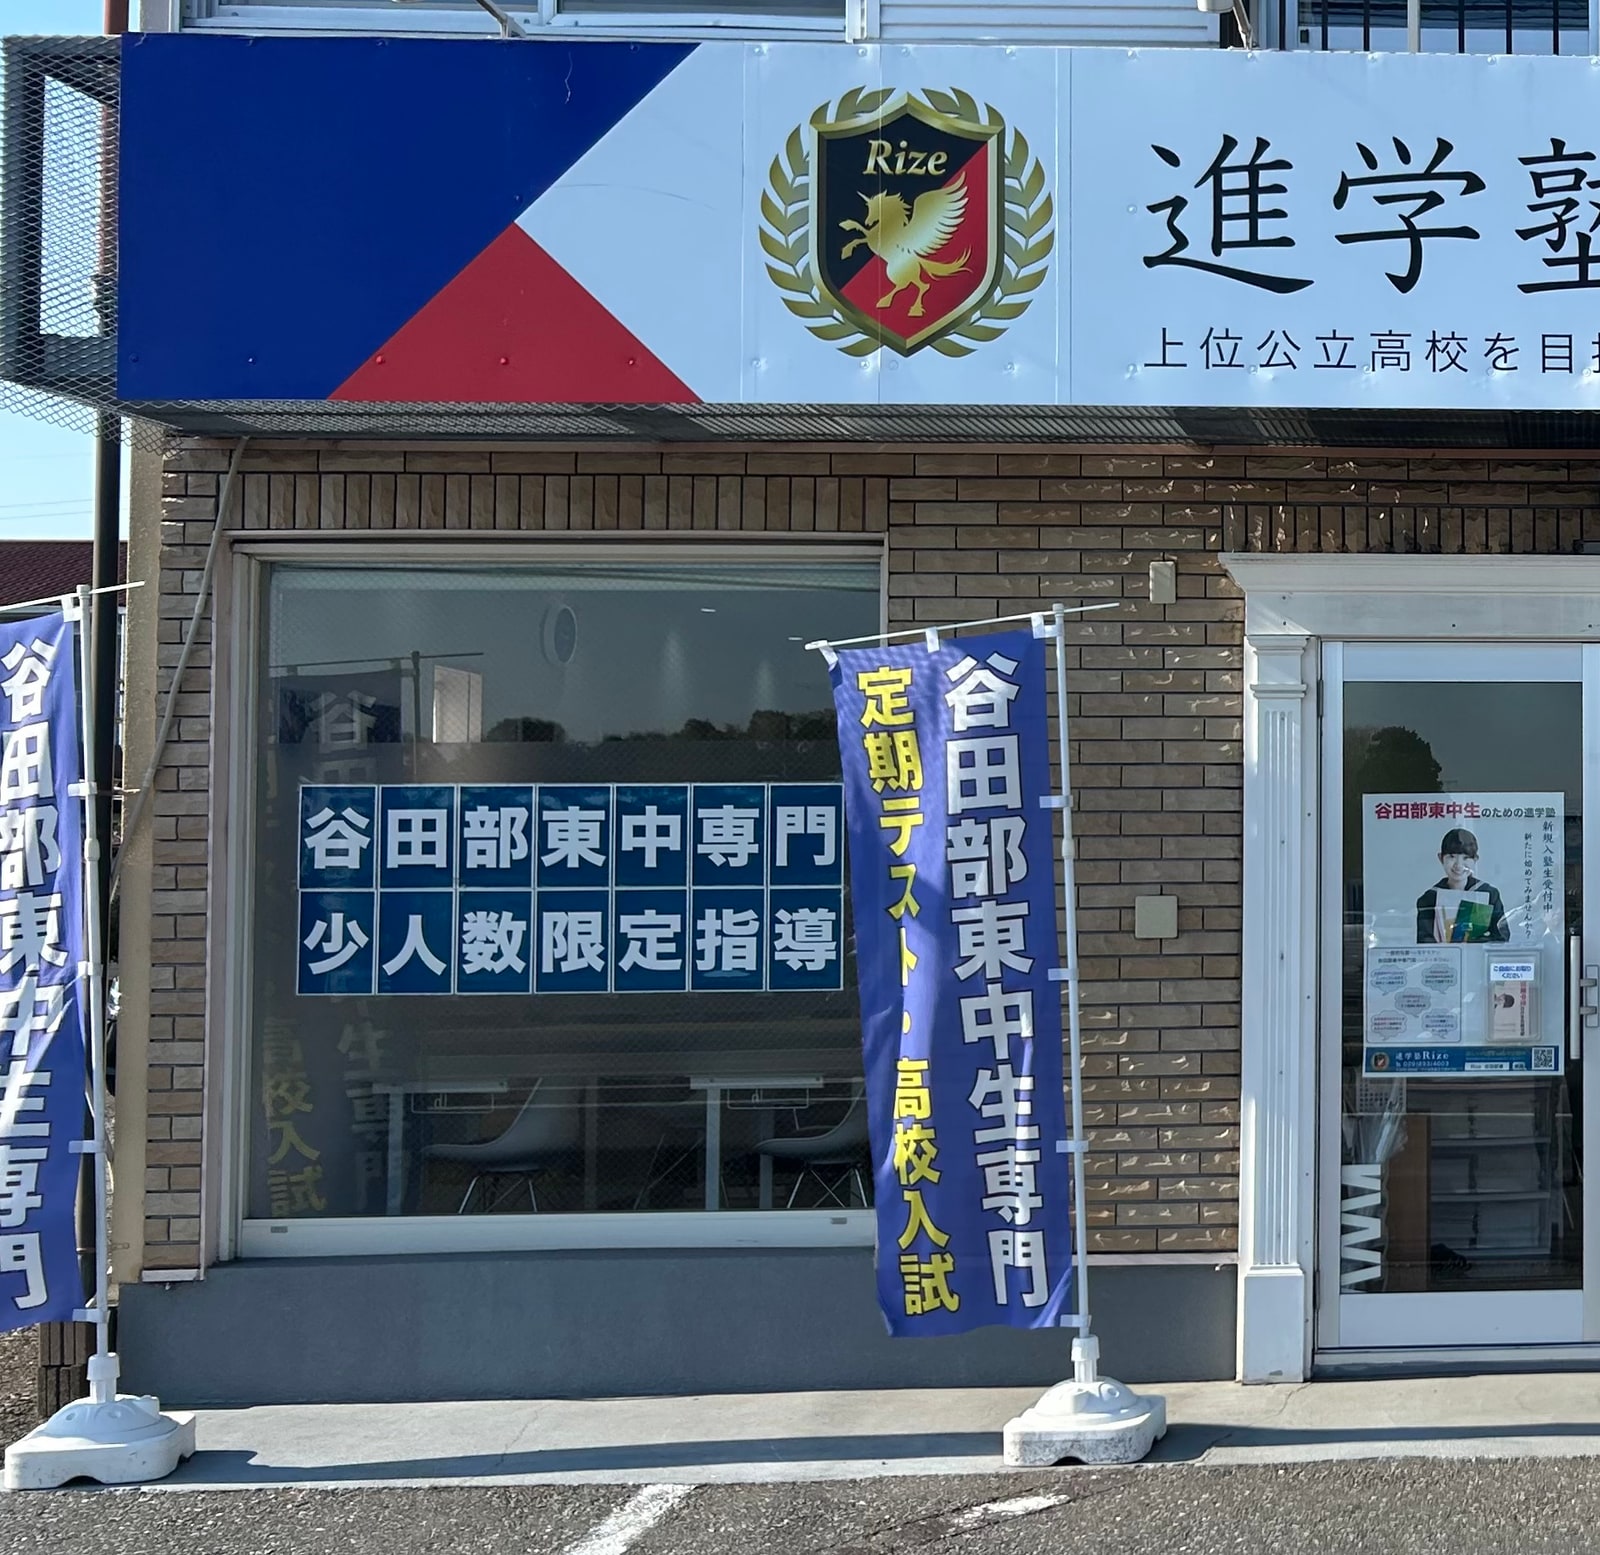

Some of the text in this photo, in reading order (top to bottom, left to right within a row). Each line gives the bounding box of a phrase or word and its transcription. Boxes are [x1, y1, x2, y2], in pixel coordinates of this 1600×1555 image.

[862, 138, 948, 178] Rize
[304, 805, 837, 871] 谷田部東中専門
[304, 907, 837, 977] 少人数限定指導
[944, 652, 1048, 1309] 谷田部東中生専門
